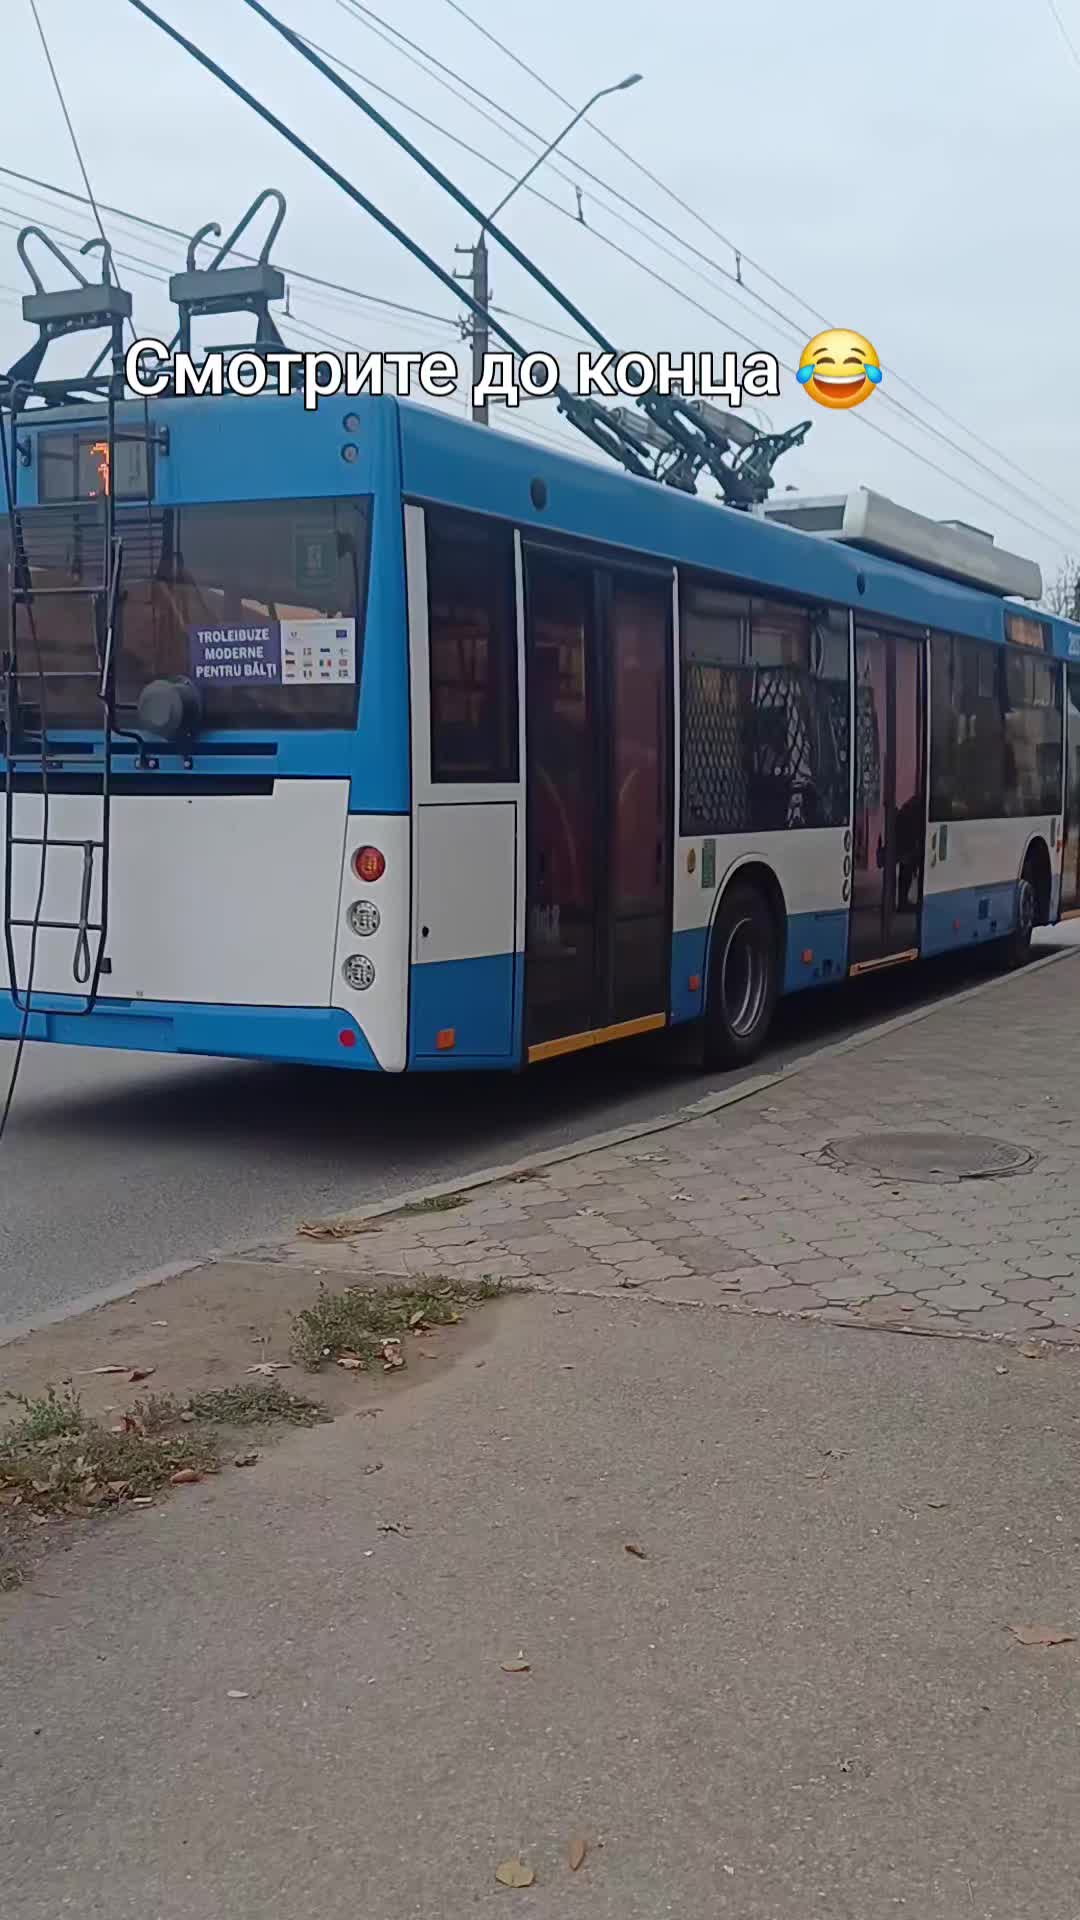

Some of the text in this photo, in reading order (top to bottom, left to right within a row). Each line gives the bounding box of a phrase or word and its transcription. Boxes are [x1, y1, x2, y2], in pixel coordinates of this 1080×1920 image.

[197, 628, 270, 643] TROLEIBUZE
[204, 646, 264, 660] MODERNE
[195, 664, 242, 678] PENTRU
